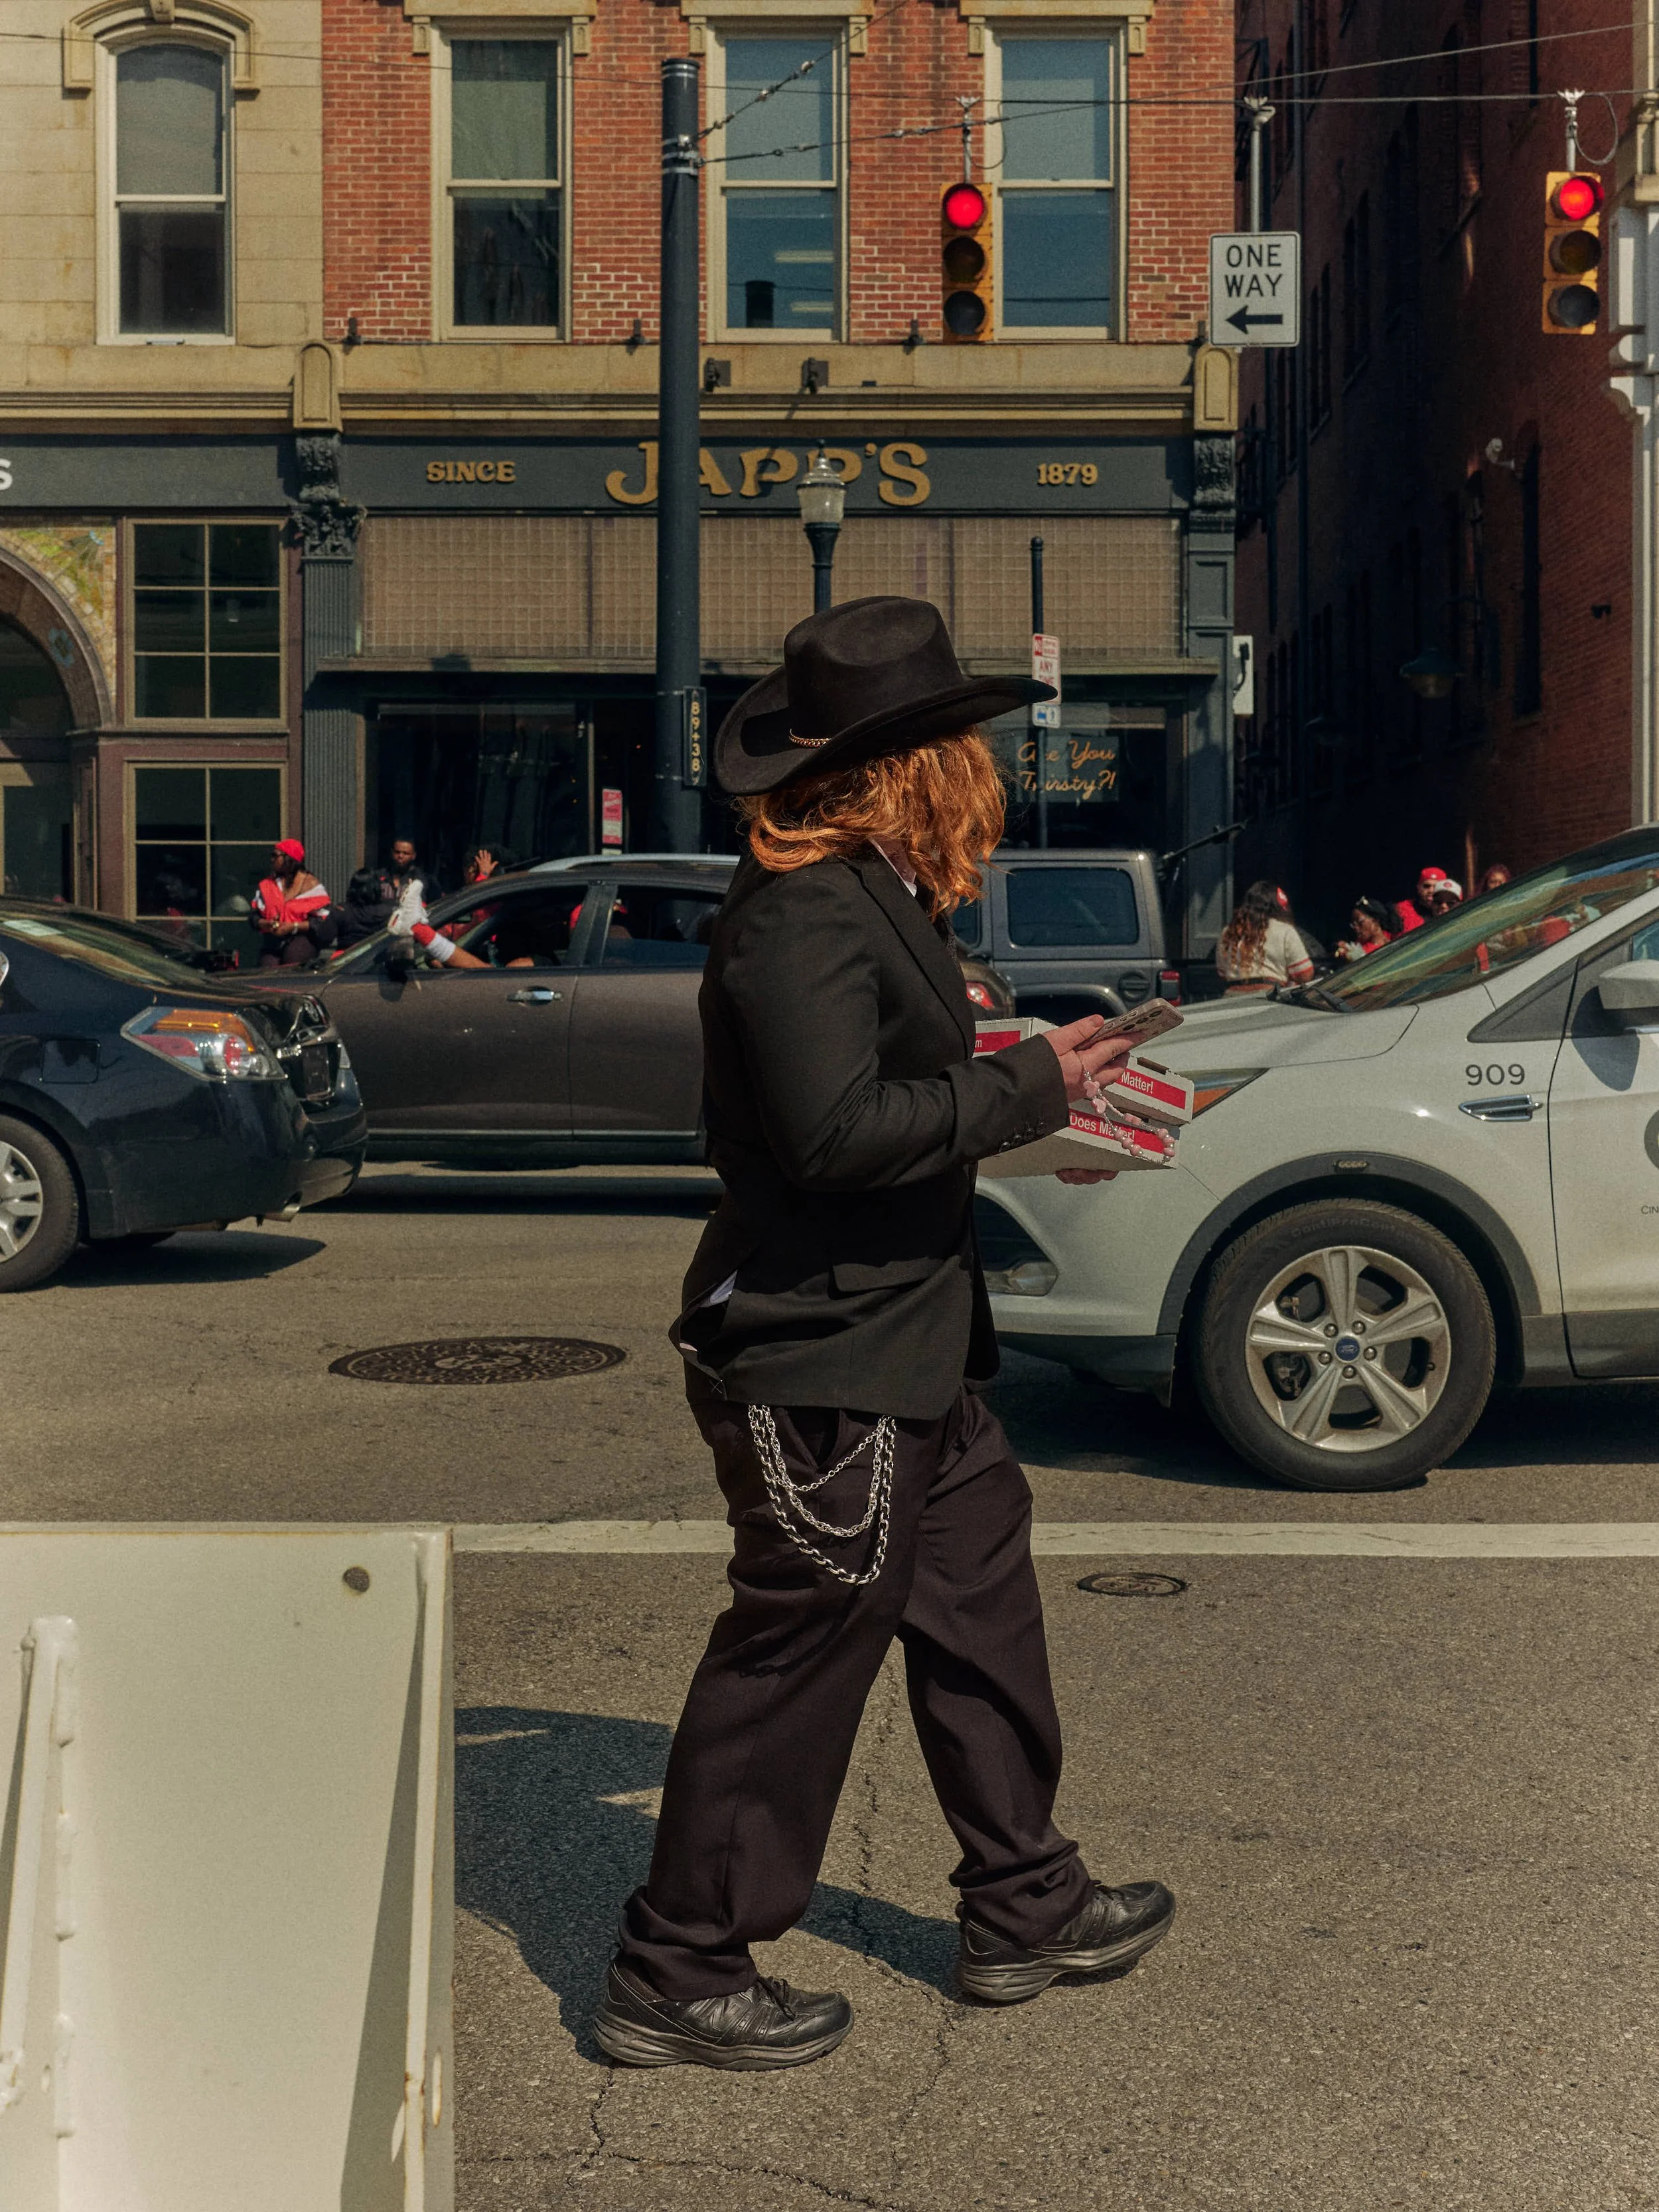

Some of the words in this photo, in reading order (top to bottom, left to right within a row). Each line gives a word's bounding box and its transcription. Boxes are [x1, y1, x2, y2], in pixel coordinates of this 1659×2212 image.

[1226, 244, 1282, 267] ONE
[1224, 273, 1283, 297] WAY
[427, 461, 516, 483] SINCE
[1037, 463, 1098, 486] 1879
[1018, 741, 1060, 762] Ae
[1068, 740, 1116, 770] You
[1019, 769, 1116, 800] Tirsty?!
[1121, 1071, 1153, 1094] Matter!
[1465, 1064, 1525, 1086] 909
[1069, 1112, 1096, 1132] Does
